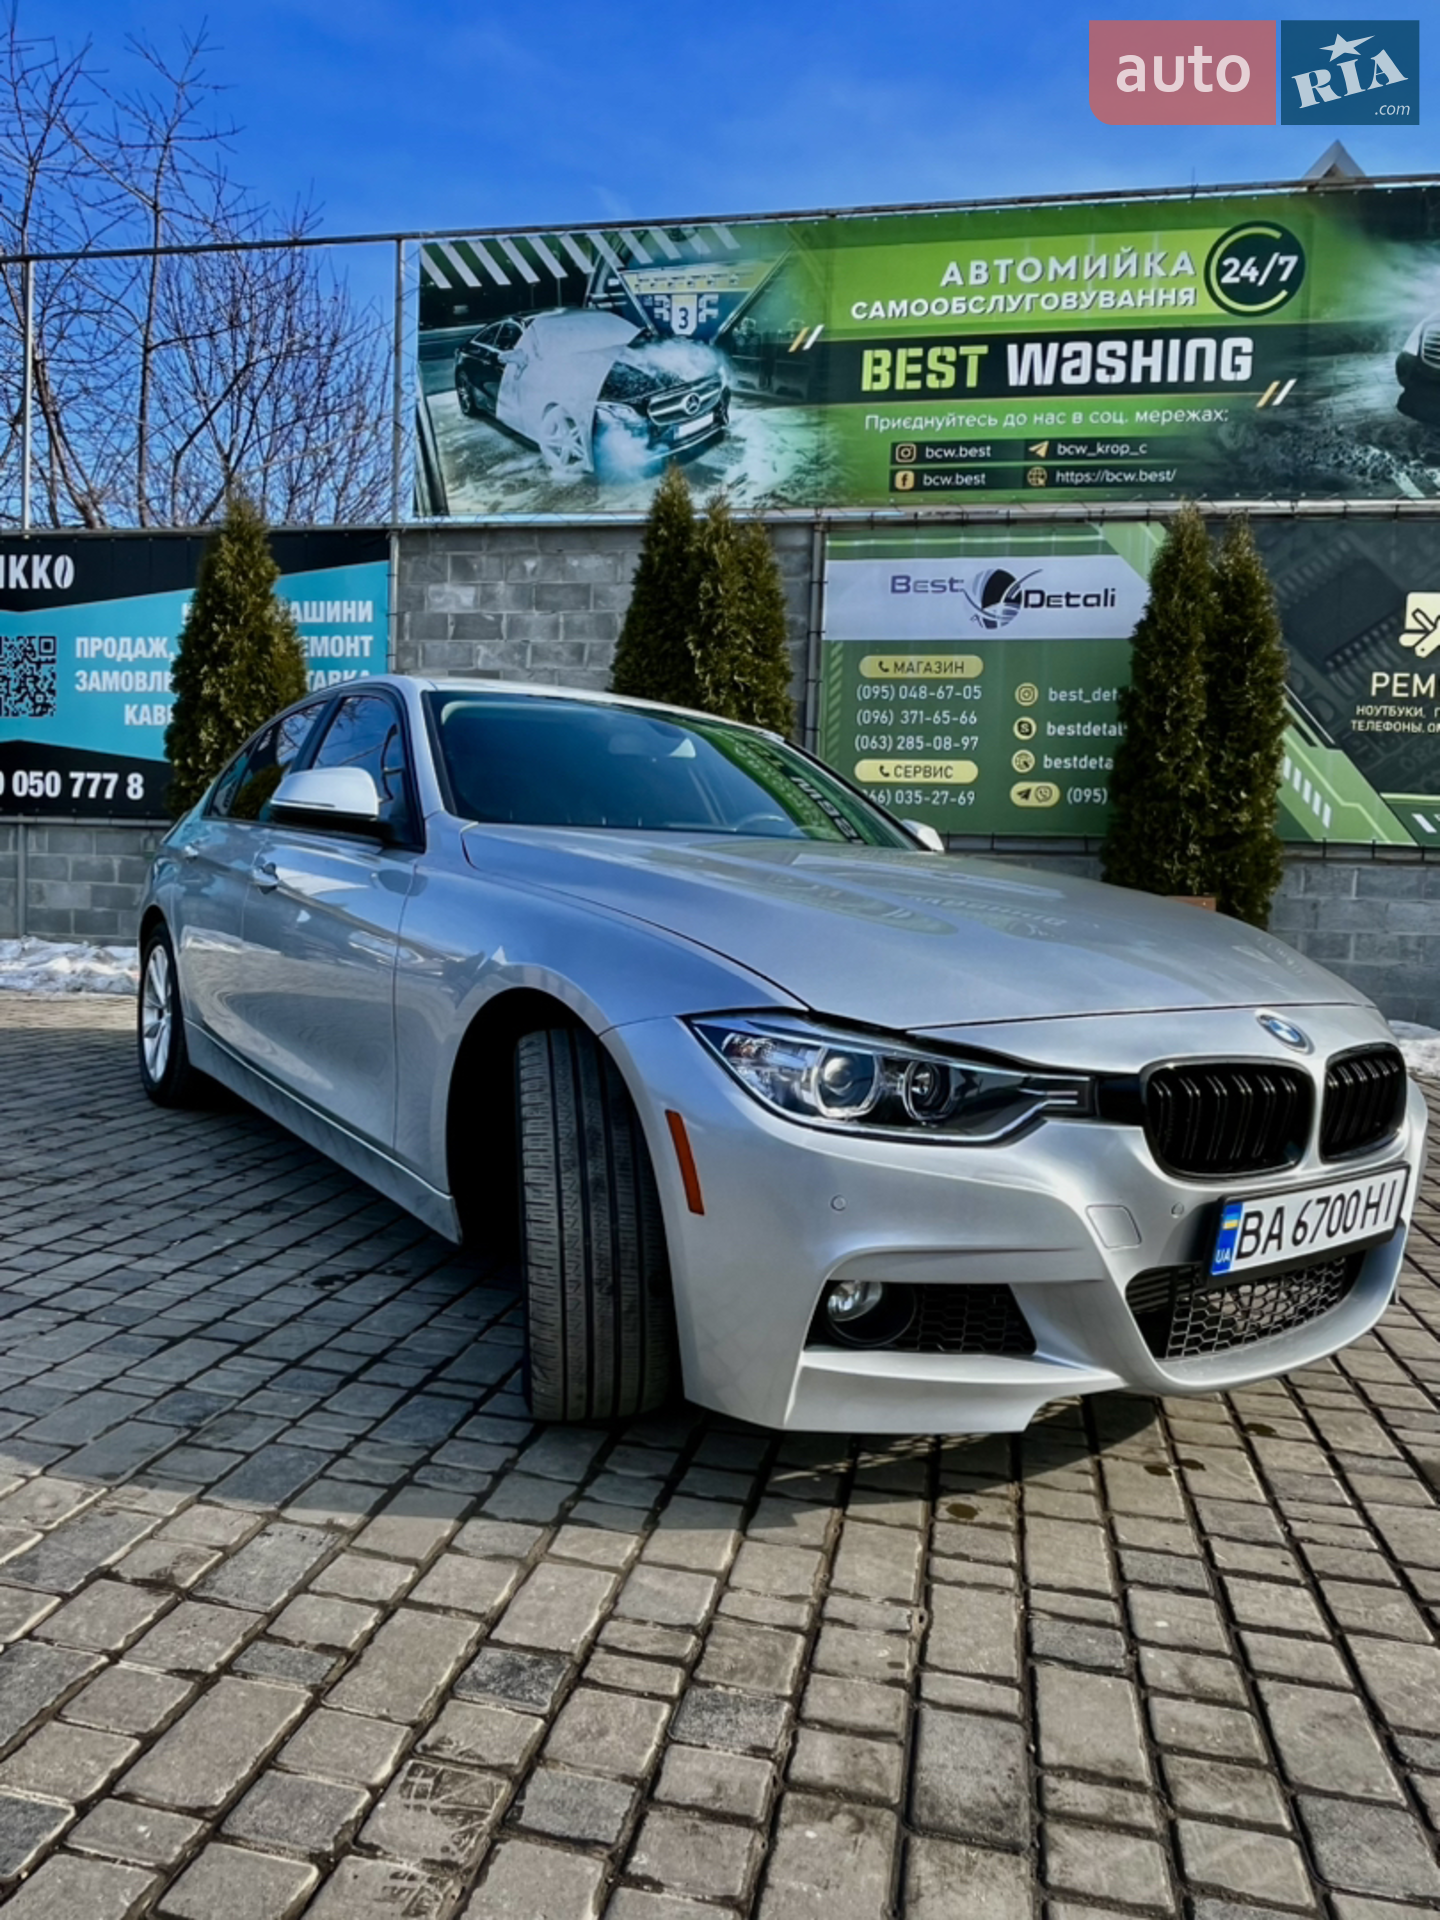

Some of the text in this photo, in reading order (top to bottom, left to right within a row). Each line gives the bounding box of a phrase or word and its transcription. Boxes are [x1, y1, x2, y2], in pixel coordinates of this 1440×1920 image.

[940, 246, 1196, 288] АВТОМИЙКА
[1220, 252, 1298, 287] 24/7
[851, 288, 1197, 320] САМООБСЛУГОВУВАННЯ
[861, 344, 989, 392] BEST
[865, 408, 1230, 433] Приєднуйтесь до нас в соц. мережах:
[925, 444, 991, 459] bcw.best
[1056, 442, 1148, 456] bcw_krop_c
[923, 472, 986, 486] bcw.best
[1055, 468, 1177, 485] https://bcw.best/
[300, 635, 374, 658] ЕМОНТ
[893, 661, 965, 675] МАГАЗИН
[856, 684, 982, 701] (095) 048-67-05
[856, 709, 977, 726] (096) 371-65-66
[854, 734, 978, 752] (063) 285-08-97
[893, 765, 954, 779] СЕРВИС
[12, 770, 61, 798] 050
[69, 771, 119, 799] 777
[126, 772, 145, 800] 8
[895, 790, 976, 806] 035-27-69
[1066, 787, 1108, 805] (095)
[1235, 1206, 1285, 1261] BA
[1291, 1188, 1362, 1247] 6700
[1214, 1248, 1231, 1264] UA
